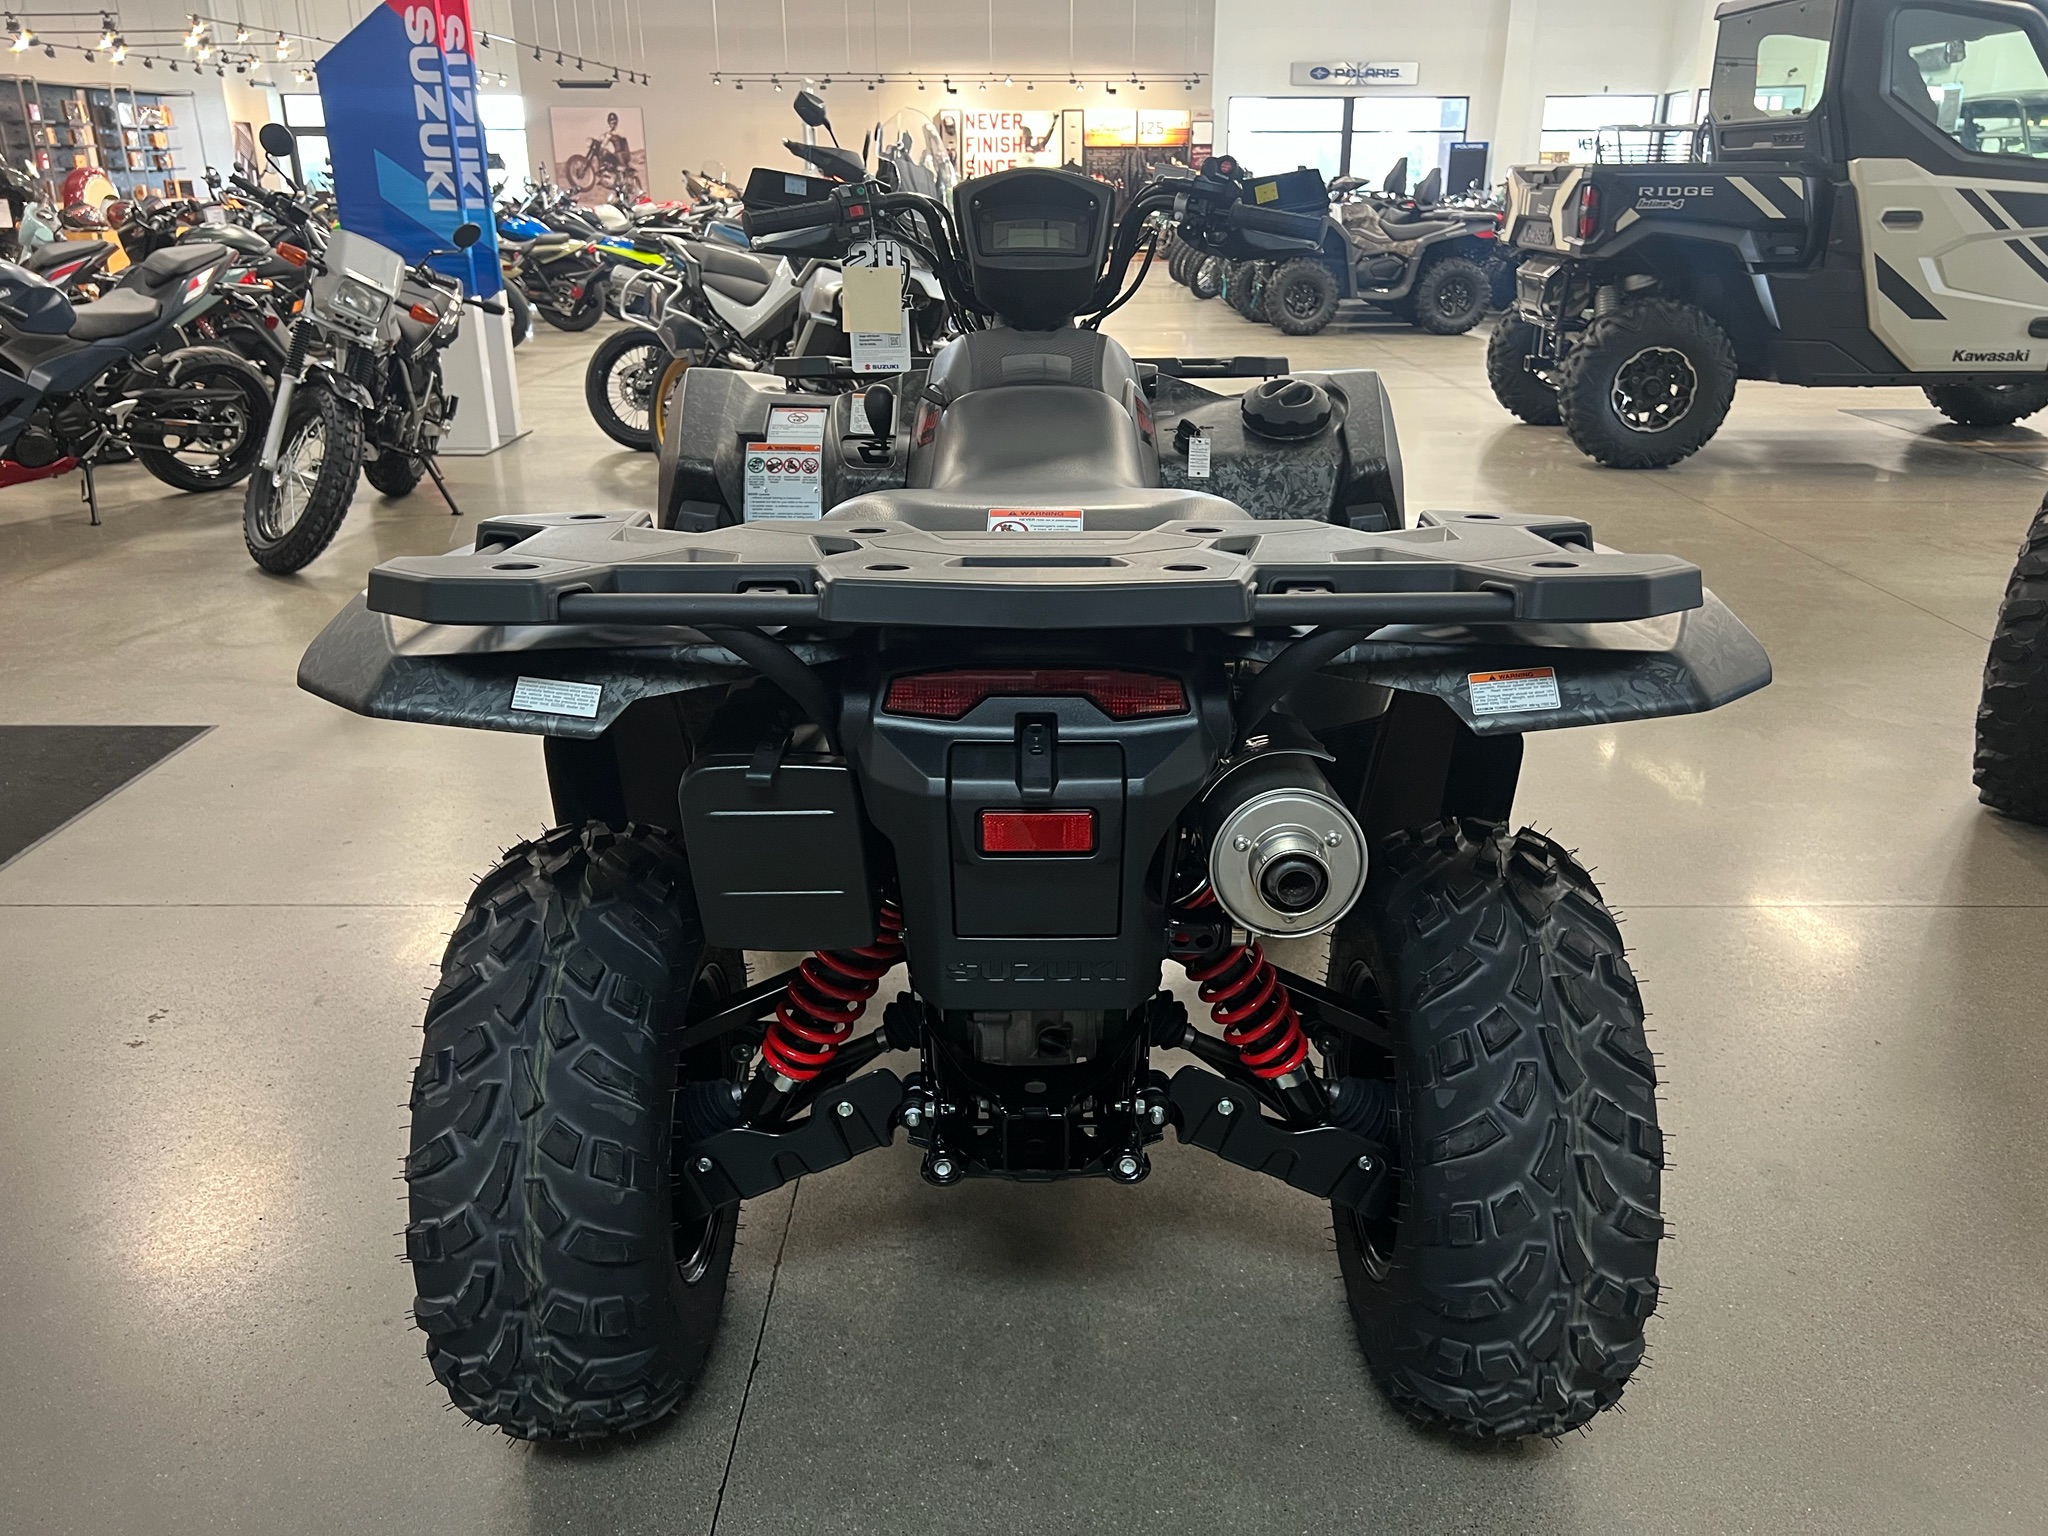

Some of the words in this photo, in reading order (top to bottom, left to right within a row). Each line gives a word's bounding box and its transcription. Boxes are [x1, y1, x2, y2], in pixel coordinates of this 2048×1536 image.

[1334, 68, 1400, 78] POLARIS
[404, 5, 458, 211] SUZUKI
[965, 112, 1023, 130] NEVER
[1140, 121, 1164, 135] 125
[1638, 186, 1714, 197] RIDGE
[1951, 349, 2031, 362] Kawasaki
[1498, 672, 1533, 680] WARNING
[946, 960, 1128, 982] SUZUKI
